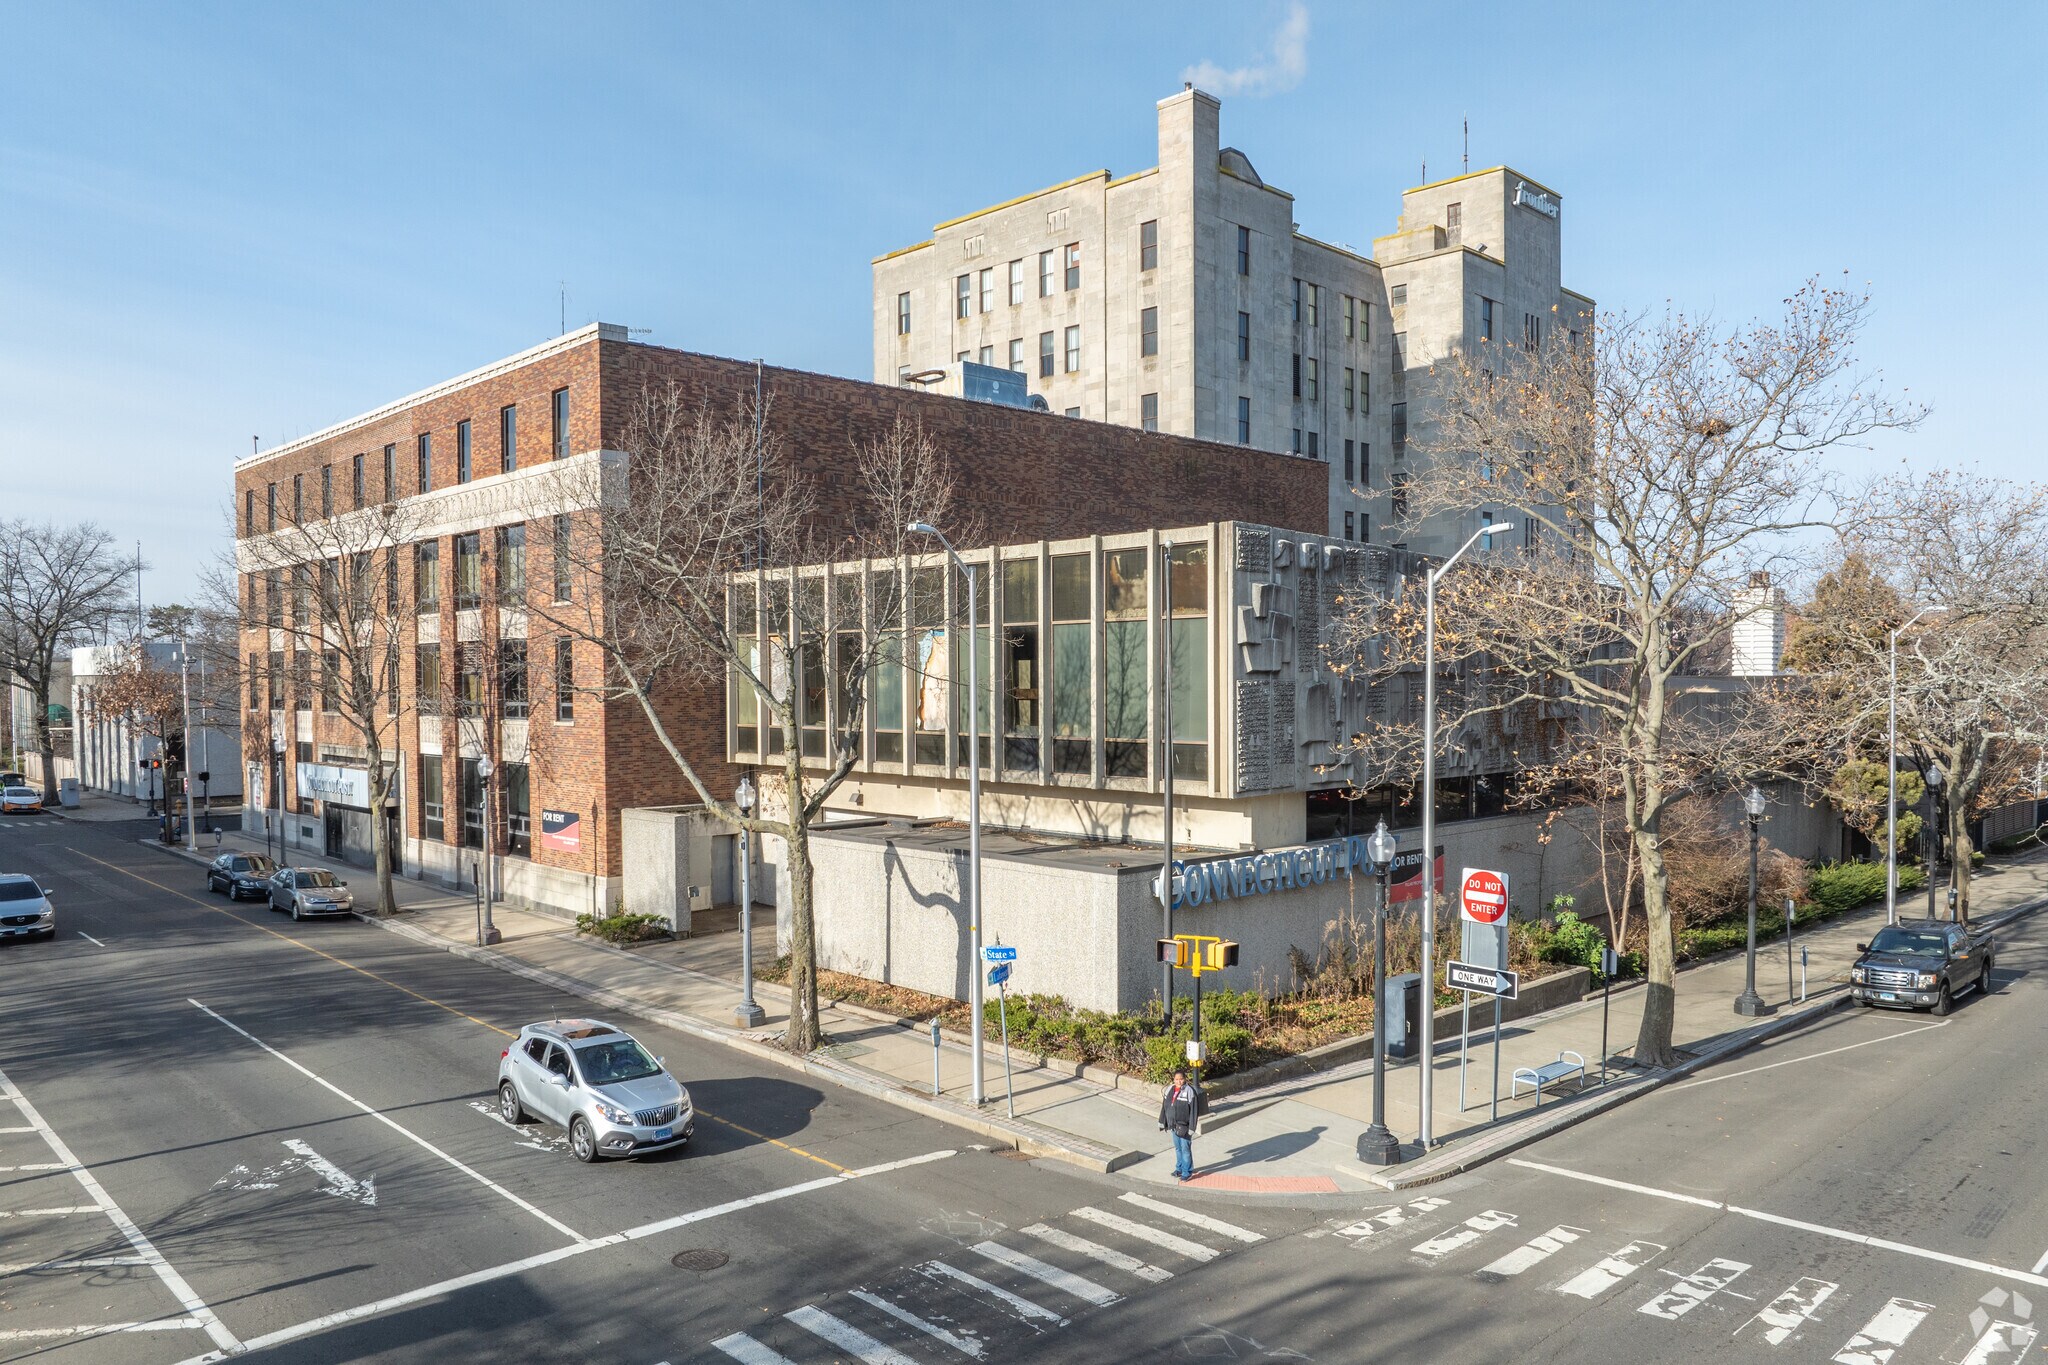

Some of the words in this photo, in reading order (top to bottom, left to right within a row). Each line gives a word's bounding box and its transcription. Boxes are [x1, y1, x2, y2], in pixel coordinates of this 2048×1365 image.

[1512, 181, 1559, 218] frontier
[543, 811, 552, 821] FOR
[553, 813, 565, 823] RENT
[1406, 853, 1423, 866] RENT
[1469, 879, 1481, 889] DO
[1485, 881, 1502, 892] NOT
[1471, 902, 1498, 915] ENTER
[987, 949, 1007, 959] State
[1457, 971, 1475, 983] ONE
[1477, 975, 1495, 986] WAY
